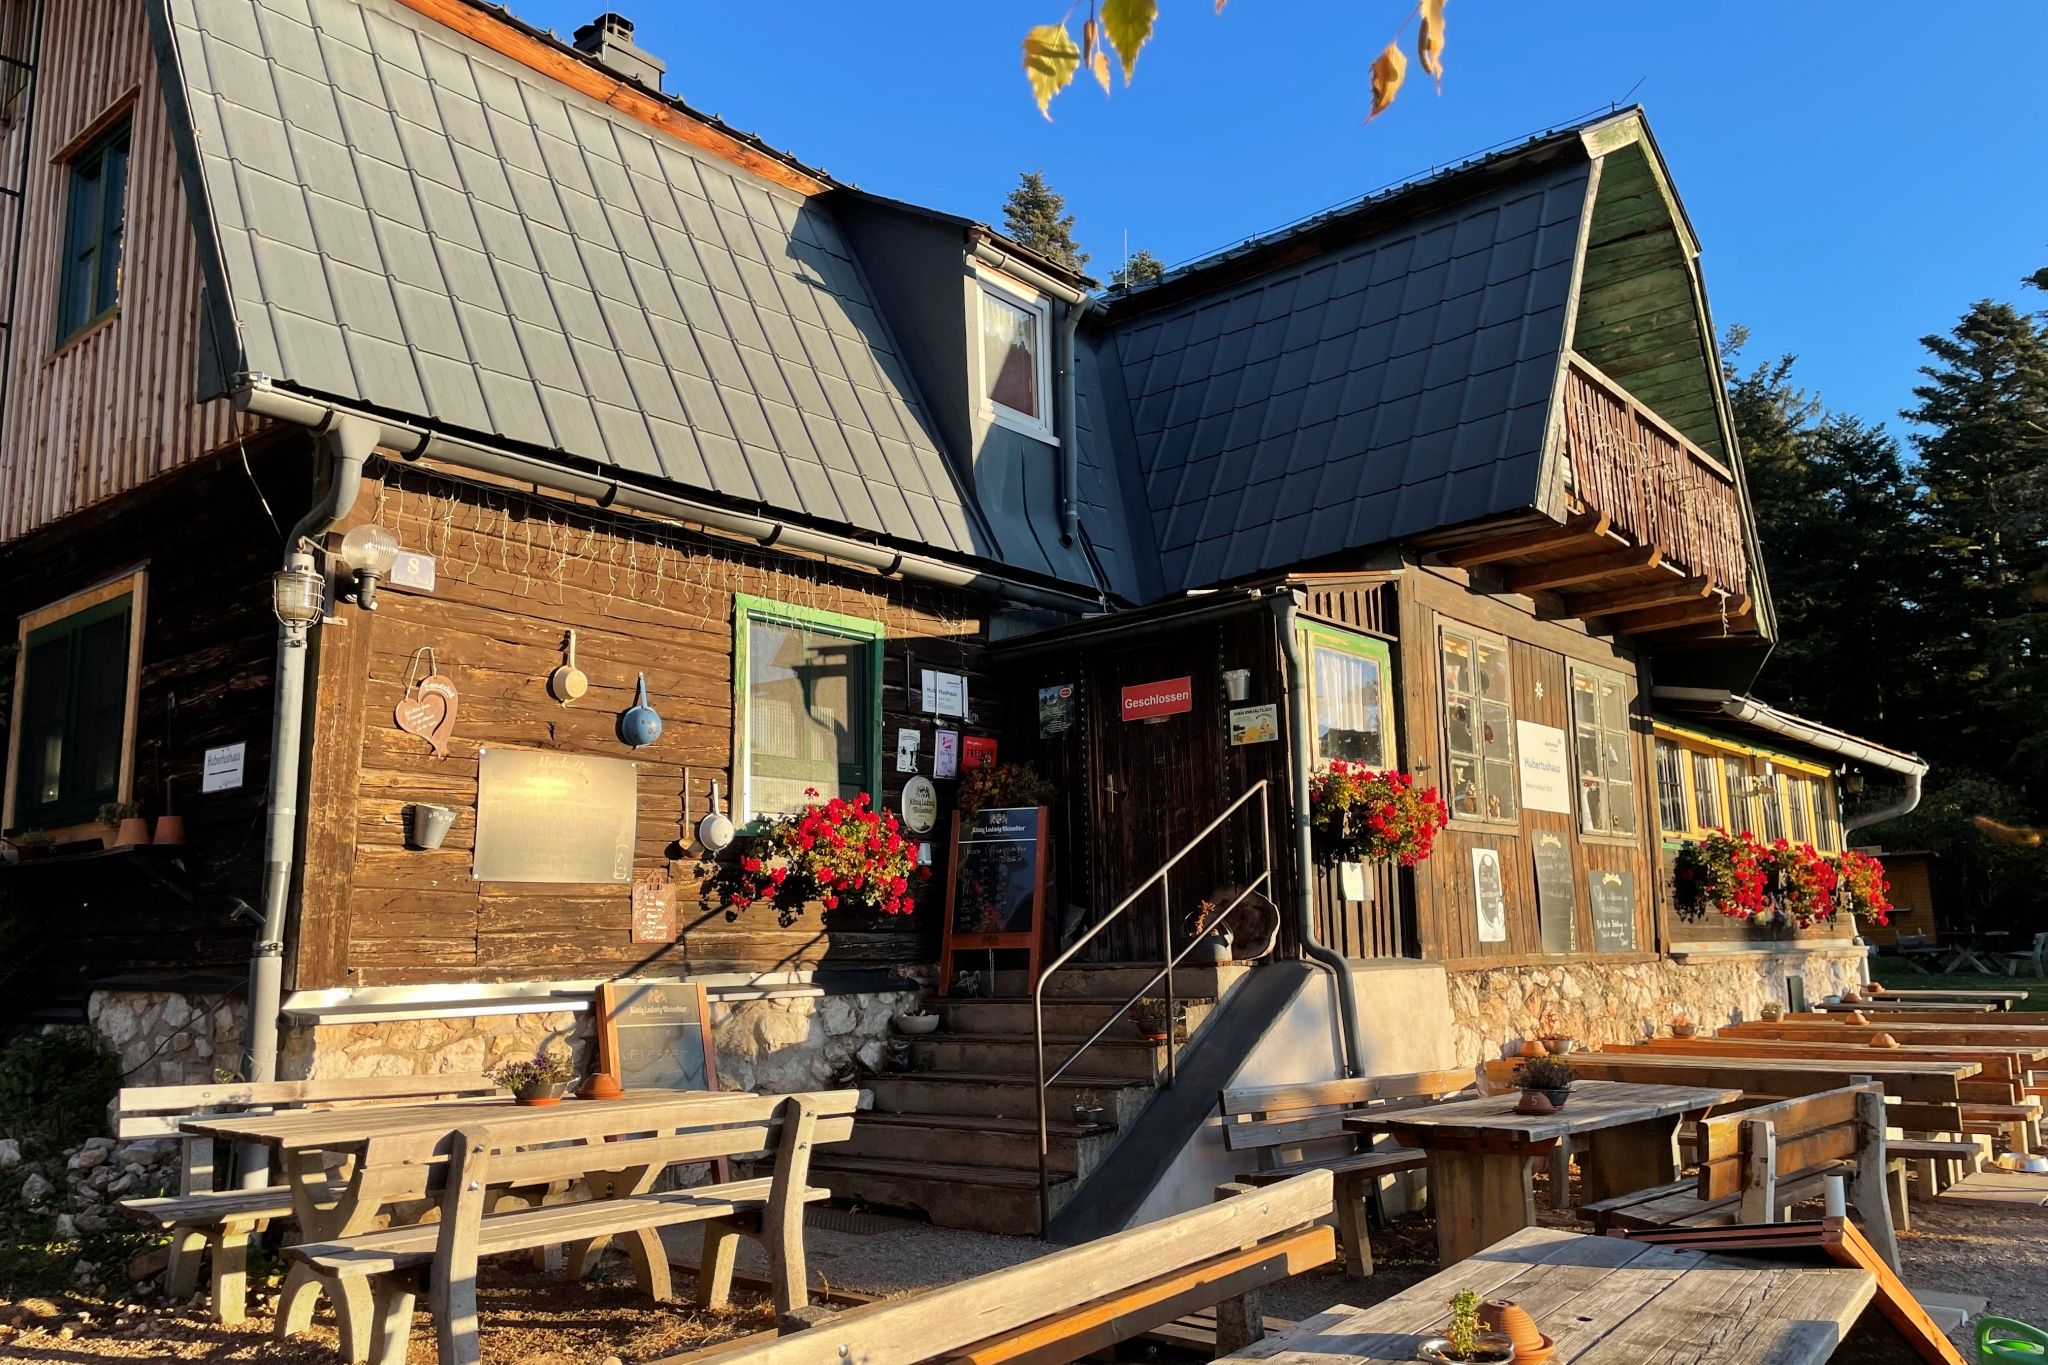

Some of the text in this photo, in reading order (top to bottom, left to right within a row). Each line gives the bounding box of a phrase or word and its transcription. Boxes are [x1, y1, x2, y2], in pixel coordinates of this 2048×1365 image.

[407, 557, 420, 574] 8
[926, 687, 957, 697] Hurtushaus
[1124, 691, 1189, 709] Geschlossen
[1524, 757, 1561, 774] Hubertushaus
[1531, 1095, 1538, 1106] 5
